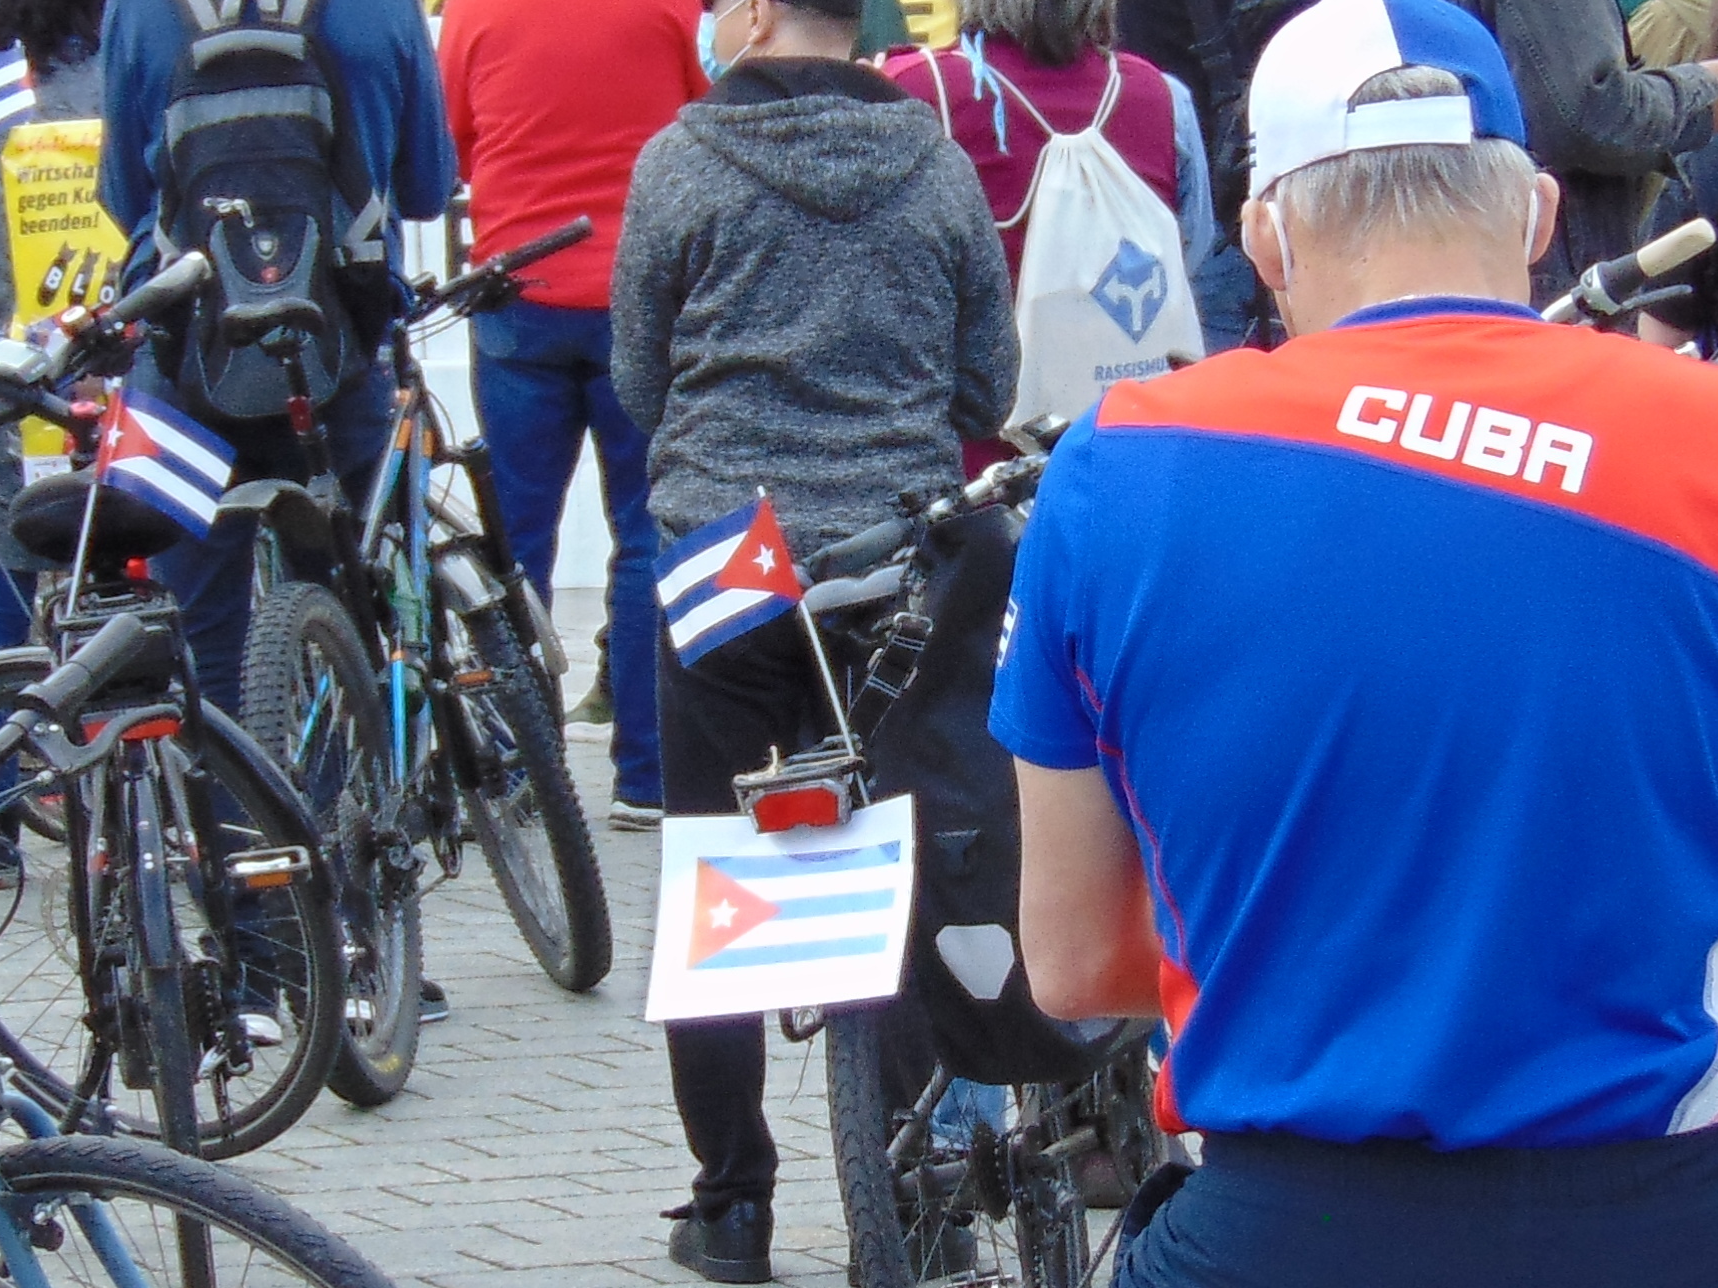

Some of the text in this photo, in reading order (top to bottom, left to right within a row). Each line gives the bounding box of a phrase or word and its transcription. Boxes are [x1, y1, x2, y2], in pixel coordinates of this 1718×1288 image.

[18, 191, 68, 214] gegen
[19, 211, 100, 236] beenden!
[1336, 385, 1594, 495] CUBA
